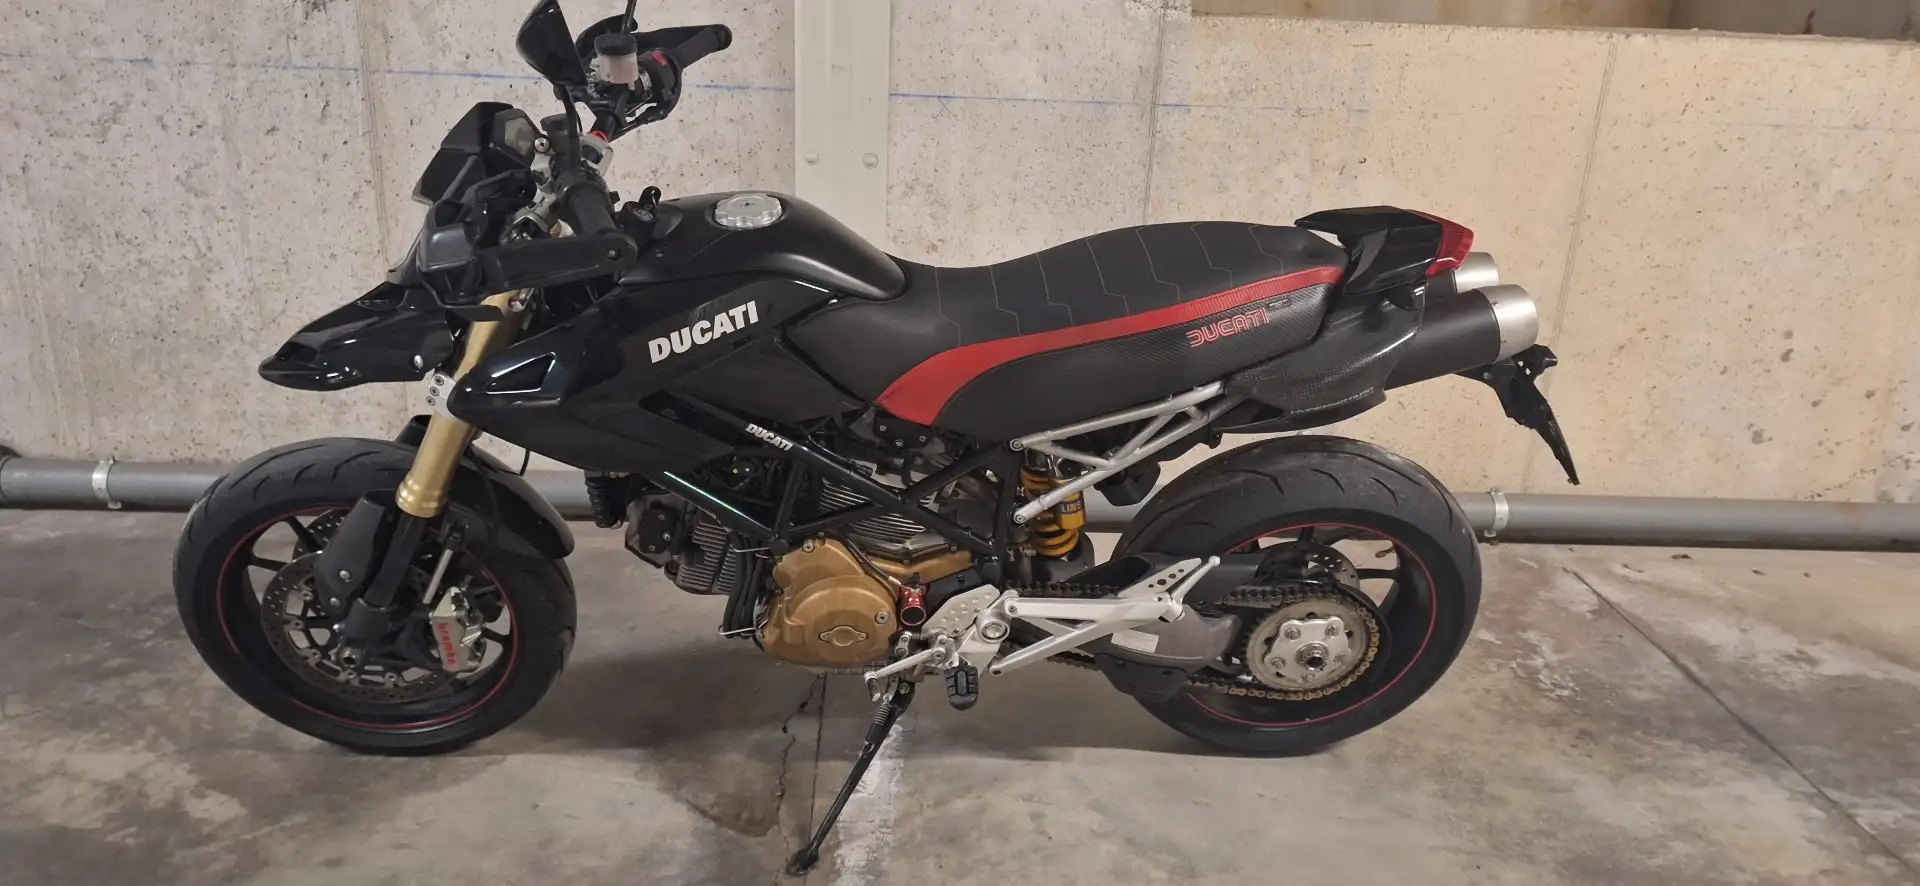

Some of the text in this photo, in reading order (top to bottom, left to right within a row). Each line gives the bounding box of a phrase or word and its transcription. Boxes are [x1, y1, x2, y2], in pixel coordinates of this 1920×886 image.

[648, 300, 759, 364] DUCATI
[1185, 308, 1270, 349] DUCATI
[745, 423, 794, 452] DUCATI
